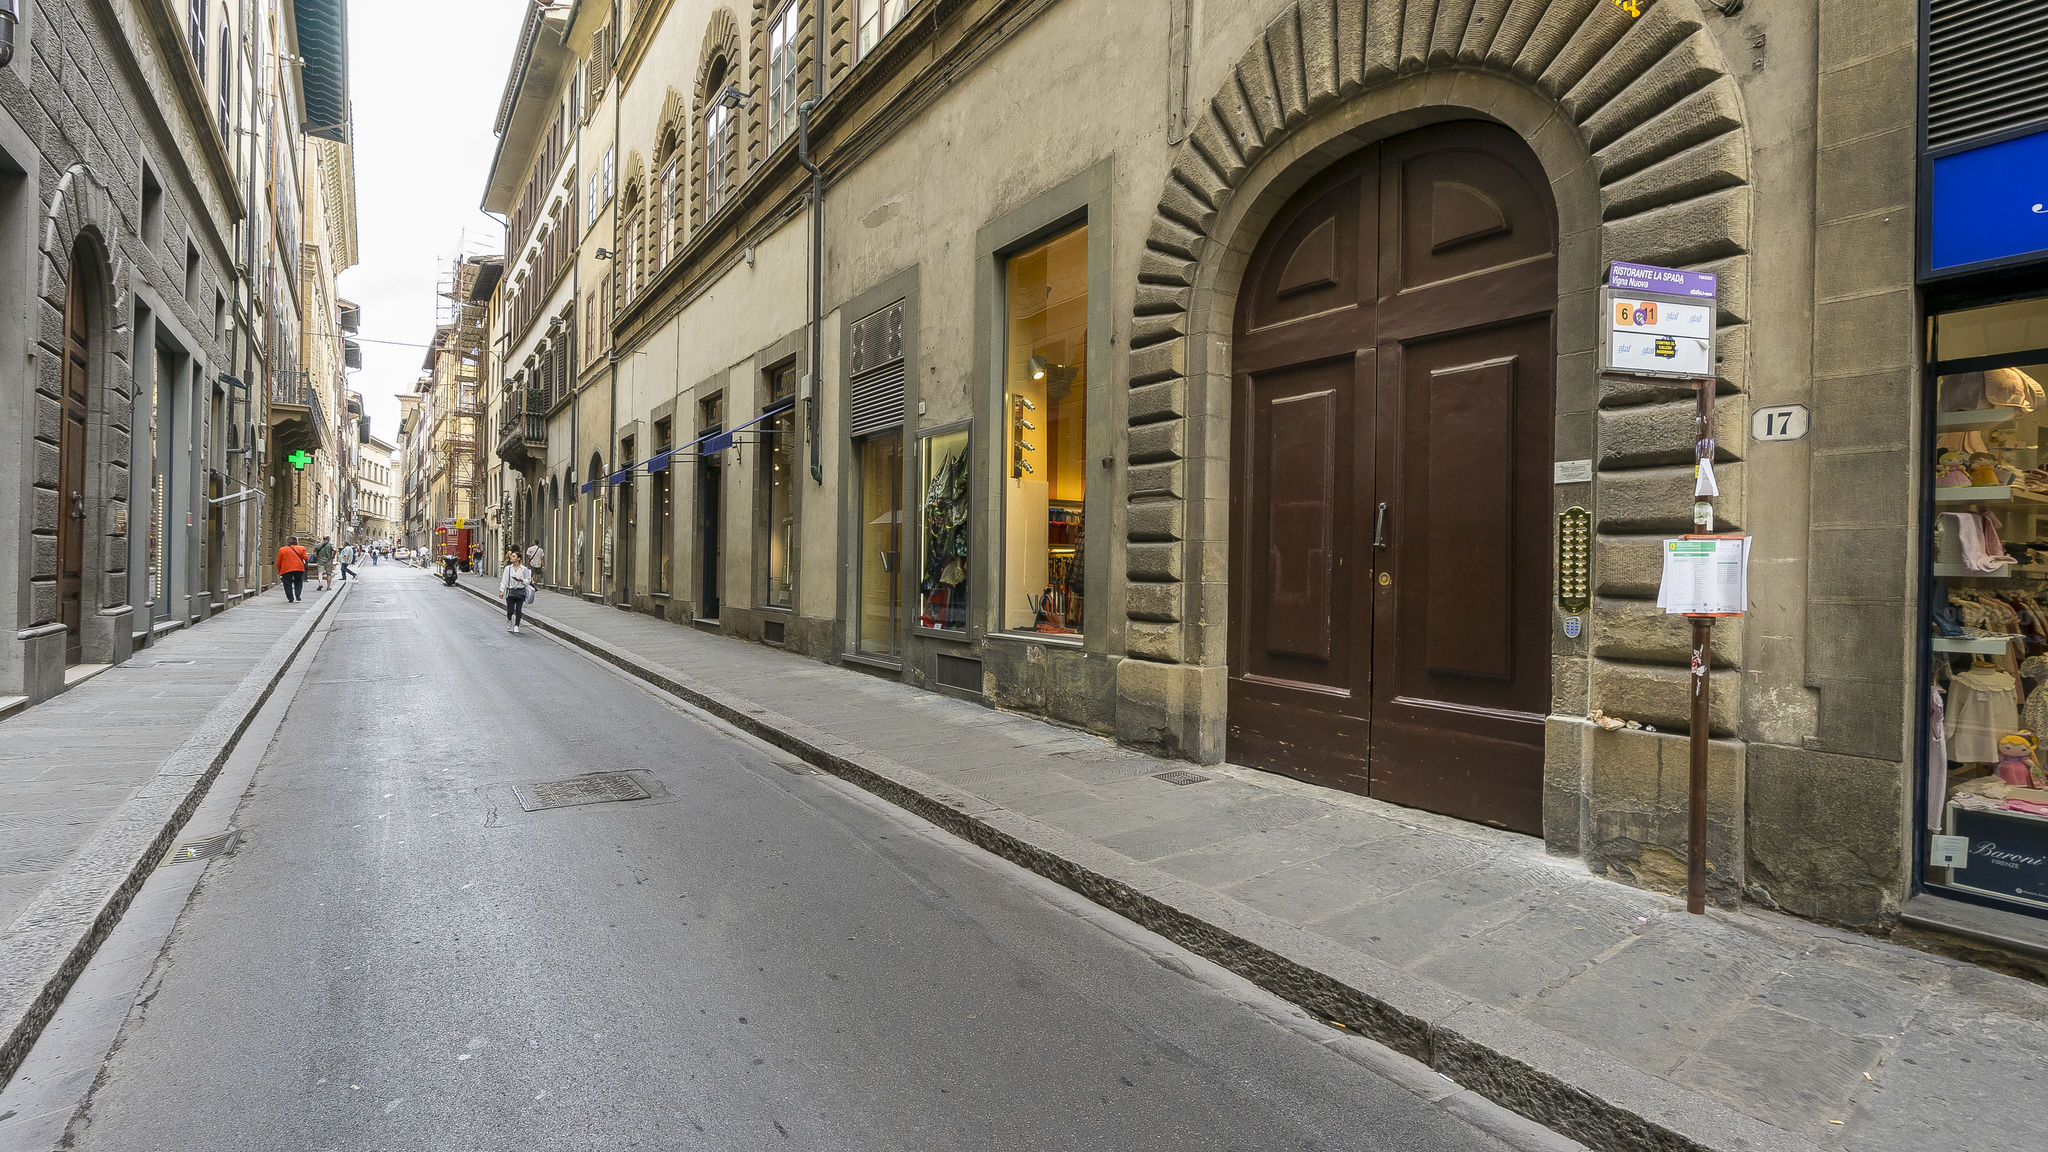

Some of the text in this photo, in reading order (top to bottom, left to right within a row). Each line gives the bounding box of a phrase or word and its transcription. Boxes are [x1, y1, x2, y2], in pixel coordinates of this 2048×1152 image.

[1612, 275, 1649, 288] Vigna Nuova
[1613, 266, 1653, 280] RISTORANTE
[1653, 271, 1662, 281] LA
[1663, 272, 1684, 284] SPADA
[1621, 308, 1629, 320] 6
[1644, 307, 1654, 320] 11
[1766, 411, 1793, 436] 17
[1968, 841, 2046, 866] Baroni
[1991, 858, 2020, 869] FIRENZE
